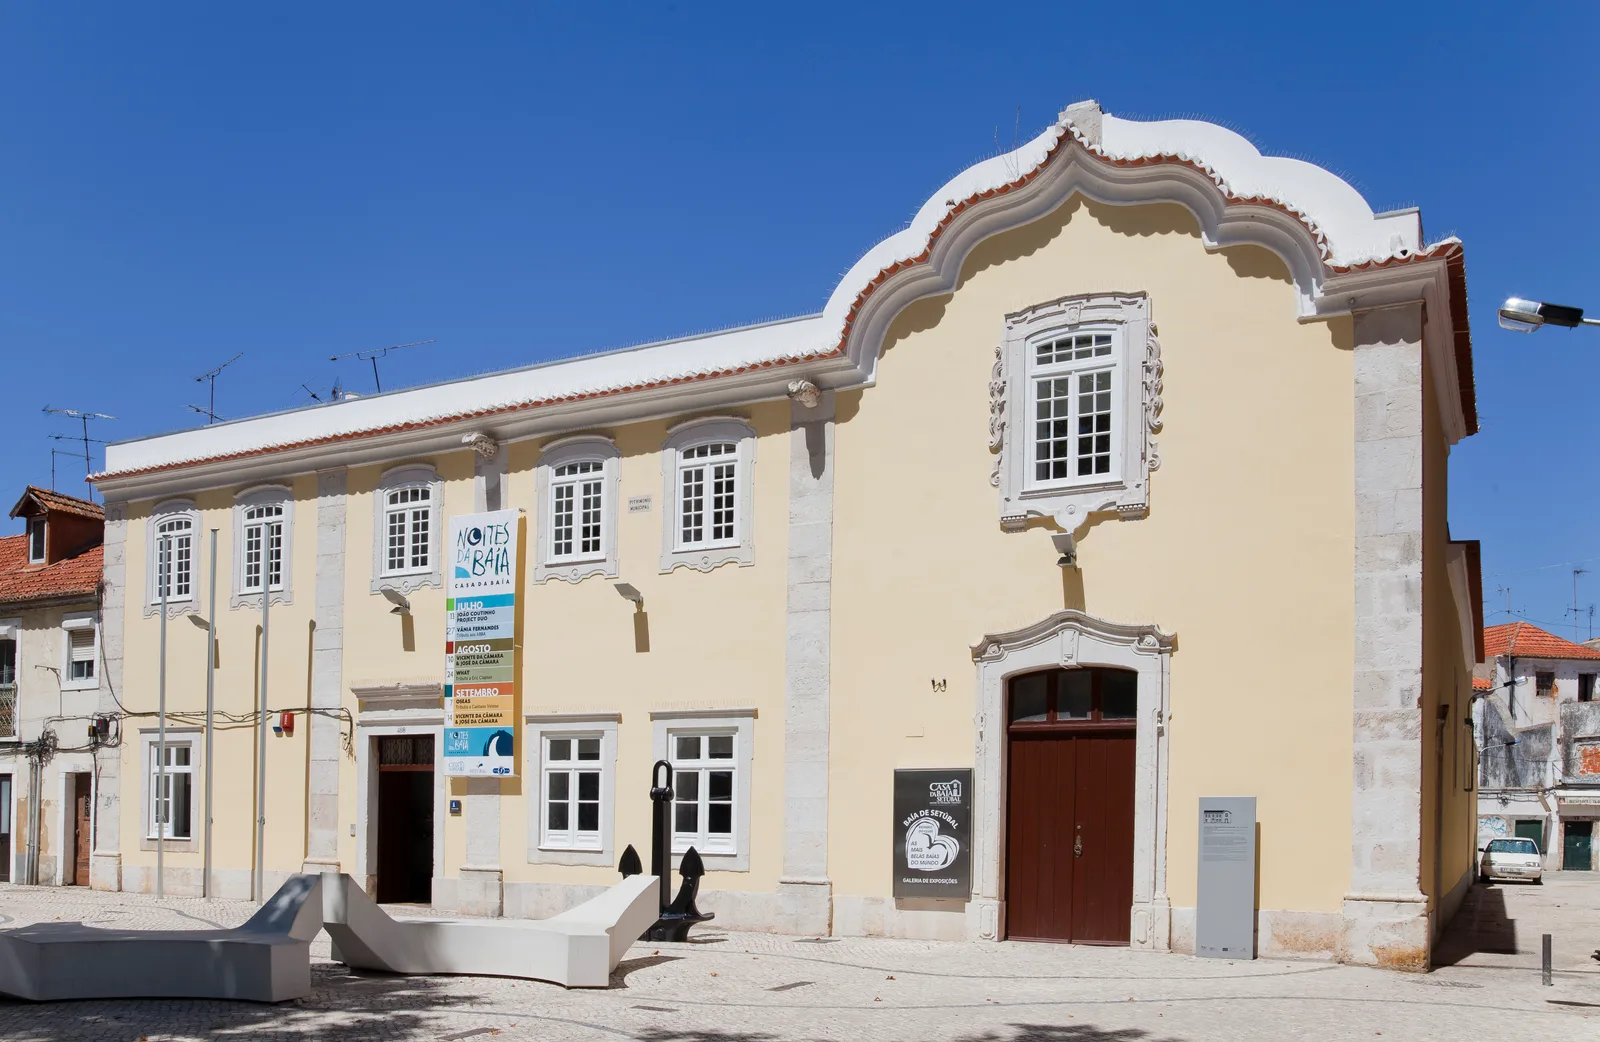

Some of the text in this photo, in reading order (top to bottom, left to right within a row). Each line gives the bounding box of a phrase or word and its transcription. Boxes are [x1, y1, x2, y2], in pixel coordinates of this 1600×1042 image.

[457, 522, 510, 549] NOITES
[457, 547, 510, 576] DA BAÍA
[457, 601, 483, 611] JULHO
[457, 644, 491, 654] AGOSTO
[456, 688, 499, 698] SETEMBRO
[930, 782, 951, 791] CASA
[903, 812, 919, 826] BAÍA
[931, 810, 959, 830] SETÚBAL
